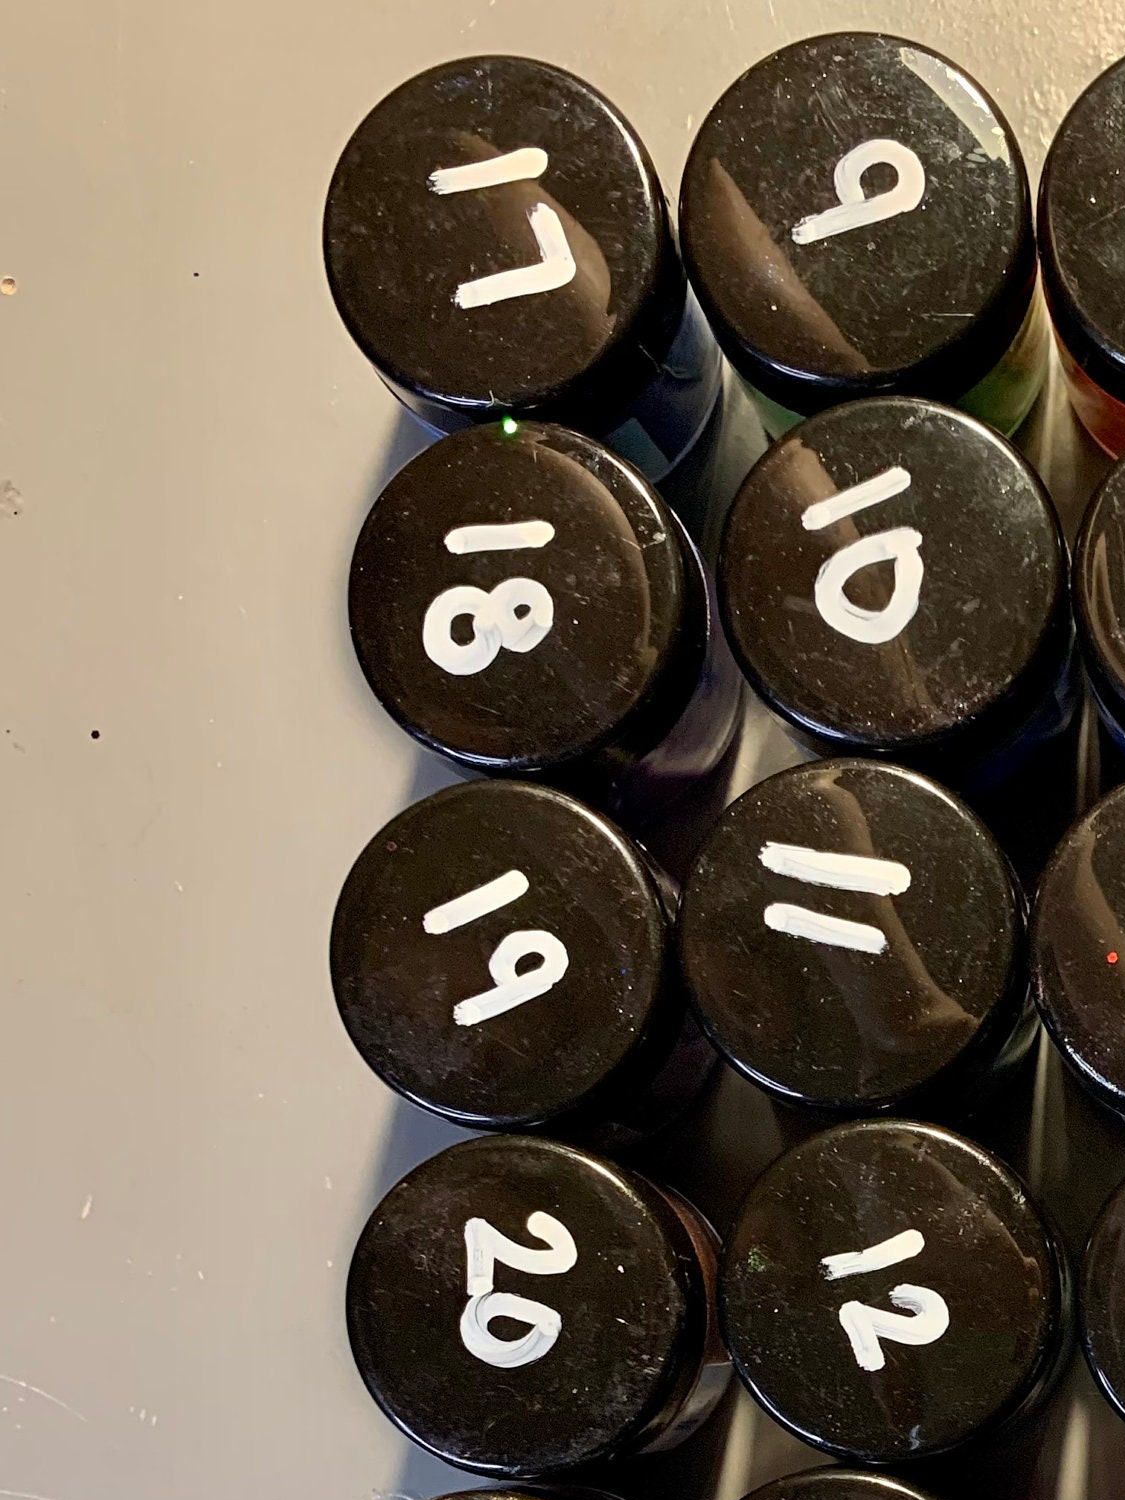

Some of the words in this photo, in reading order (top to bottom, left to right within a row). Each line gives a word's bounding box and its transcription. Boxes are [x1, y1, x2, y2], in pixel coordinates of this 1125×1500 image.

[429, 148, 576, 309] 17
[790, 138, 926, 246] 9
[423, 521, 555, 675] 18
[802, 467, 923, 644] 10
[423, 870, 568, 1026] 19
[758, 842, 911, 954] 11
[460, 1211, 577, 1367] 20
[822, 1230, 949, 1371] 12
